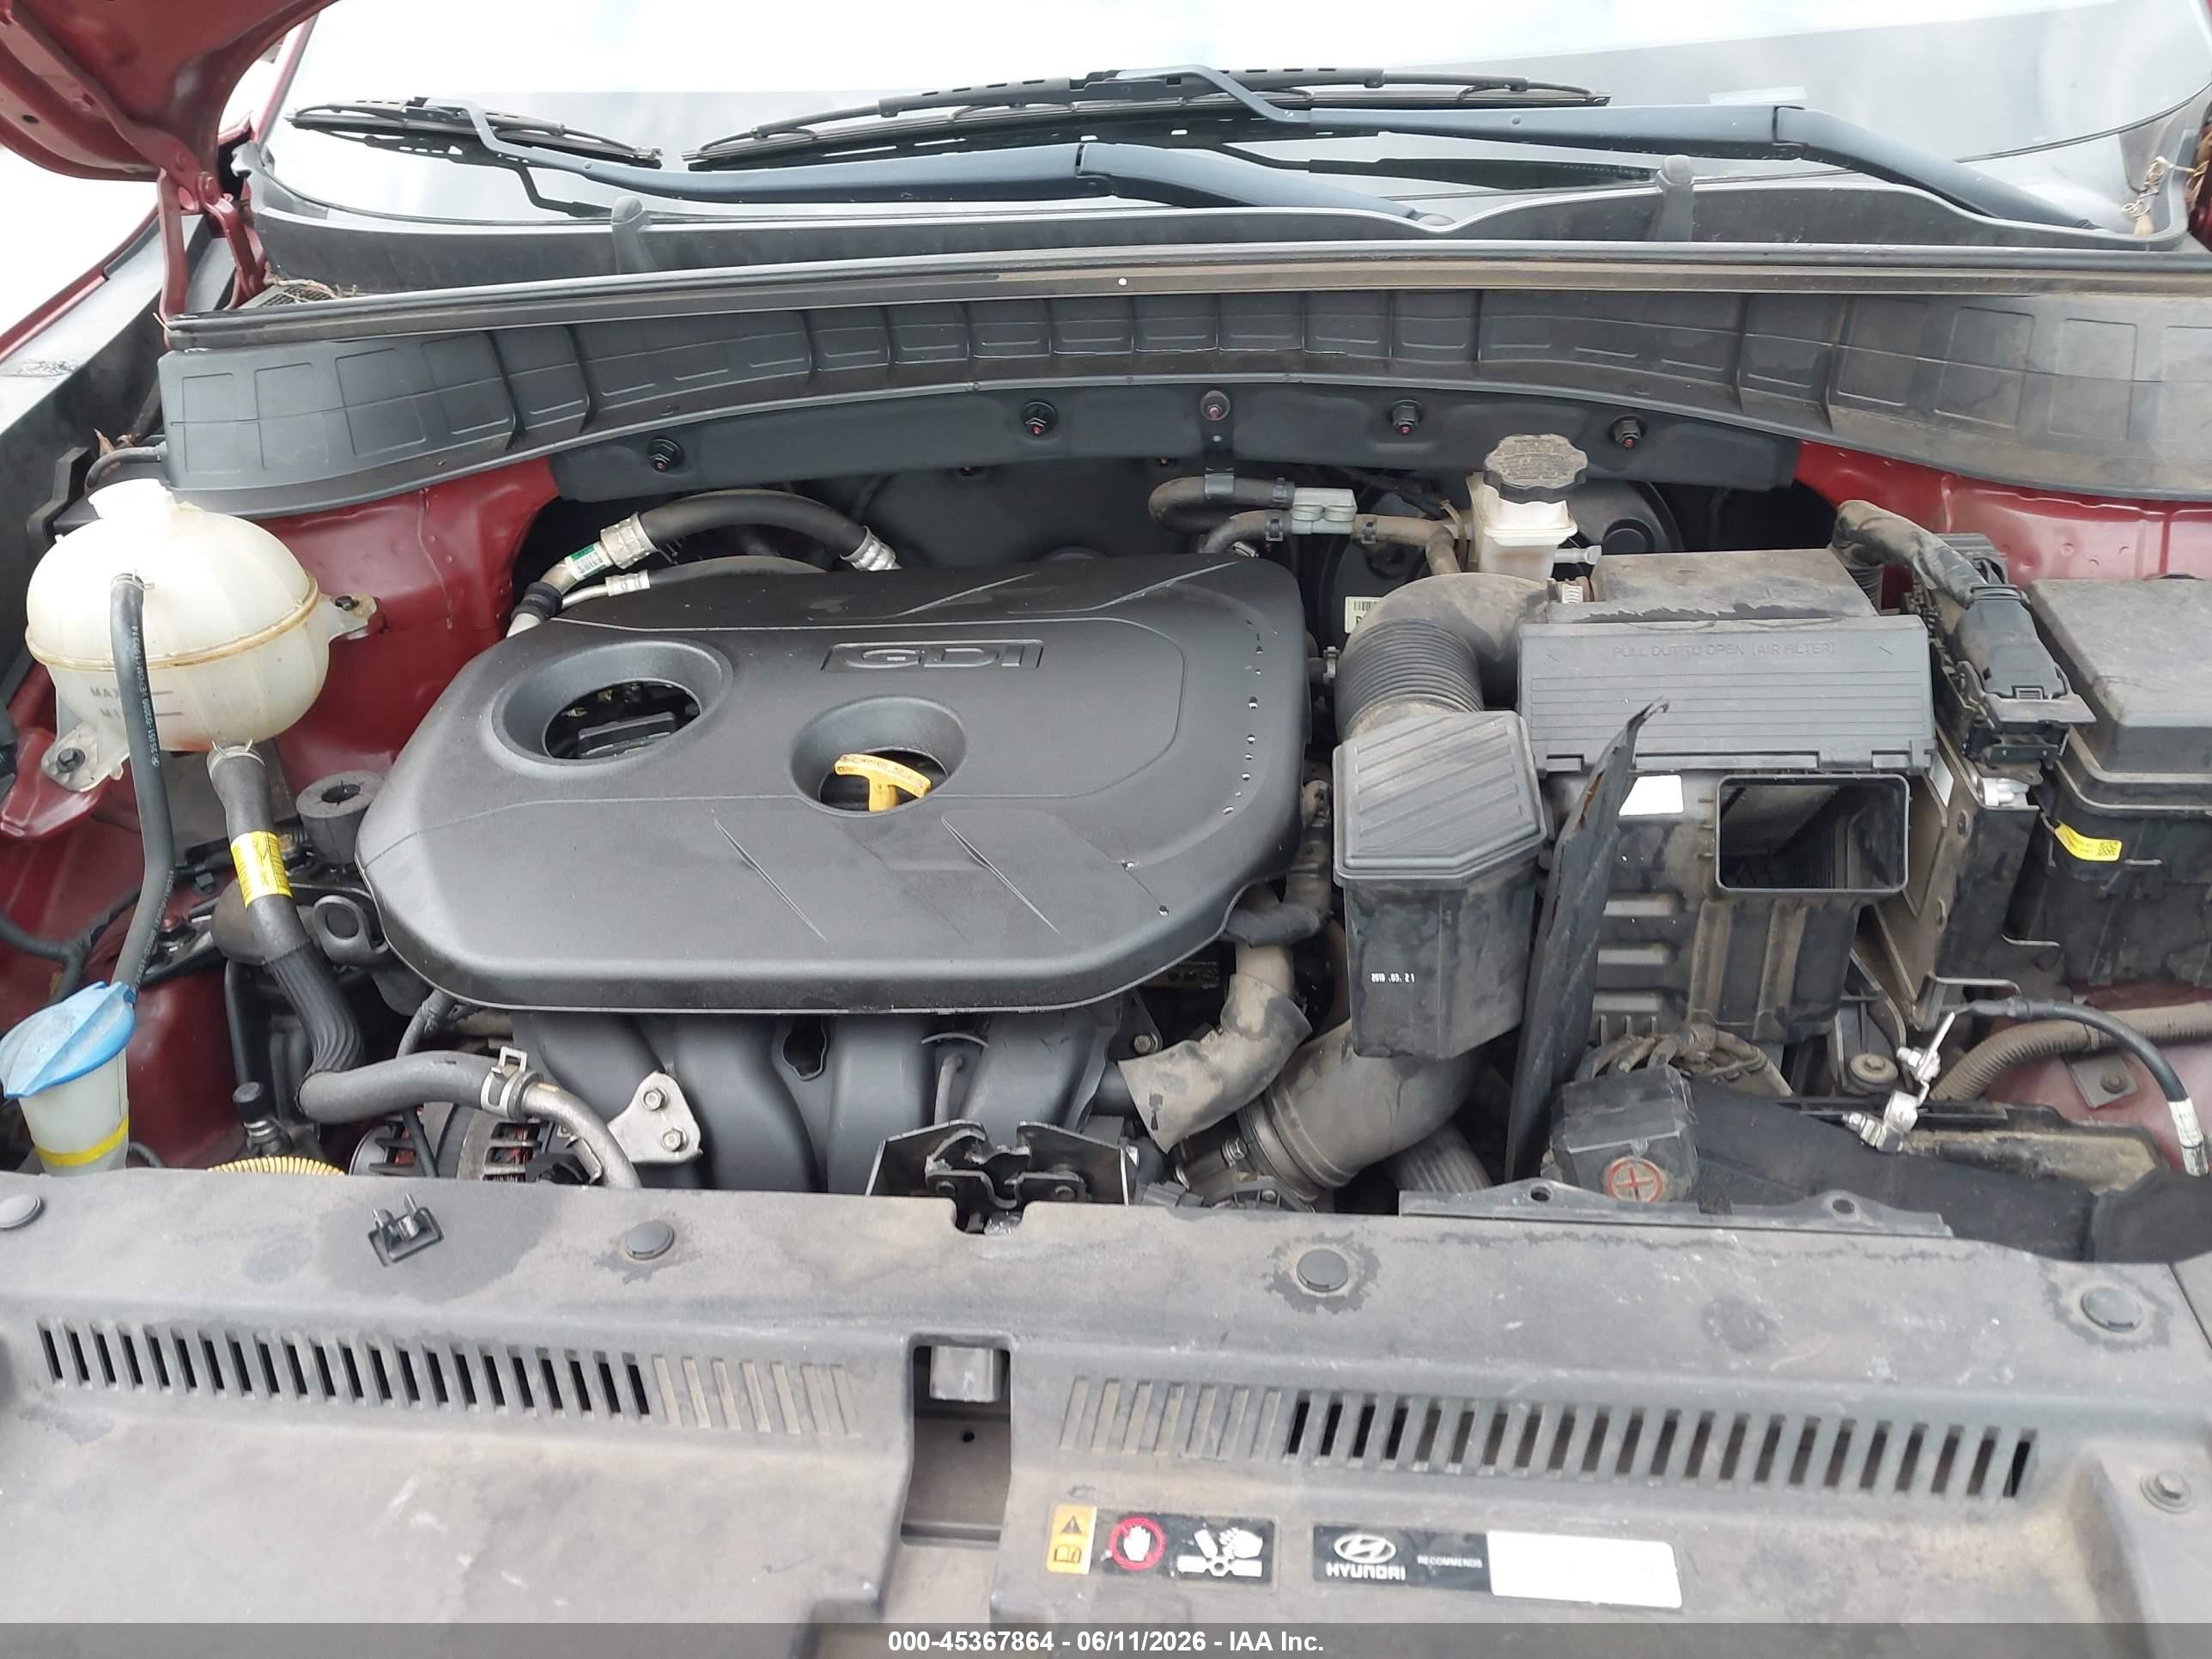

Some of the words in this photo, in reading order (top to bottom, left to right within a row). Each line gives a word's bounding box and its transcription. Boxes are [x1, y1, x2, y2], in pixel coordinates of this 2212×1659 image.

[845, 647, 1025, 669] GDI
[1705, 643, 1746, 656] OPEN
[1417, 1554, 1484, 1570] RECOMMENDS
[1325, 1562, 1407, 1582] HYUNDAI
